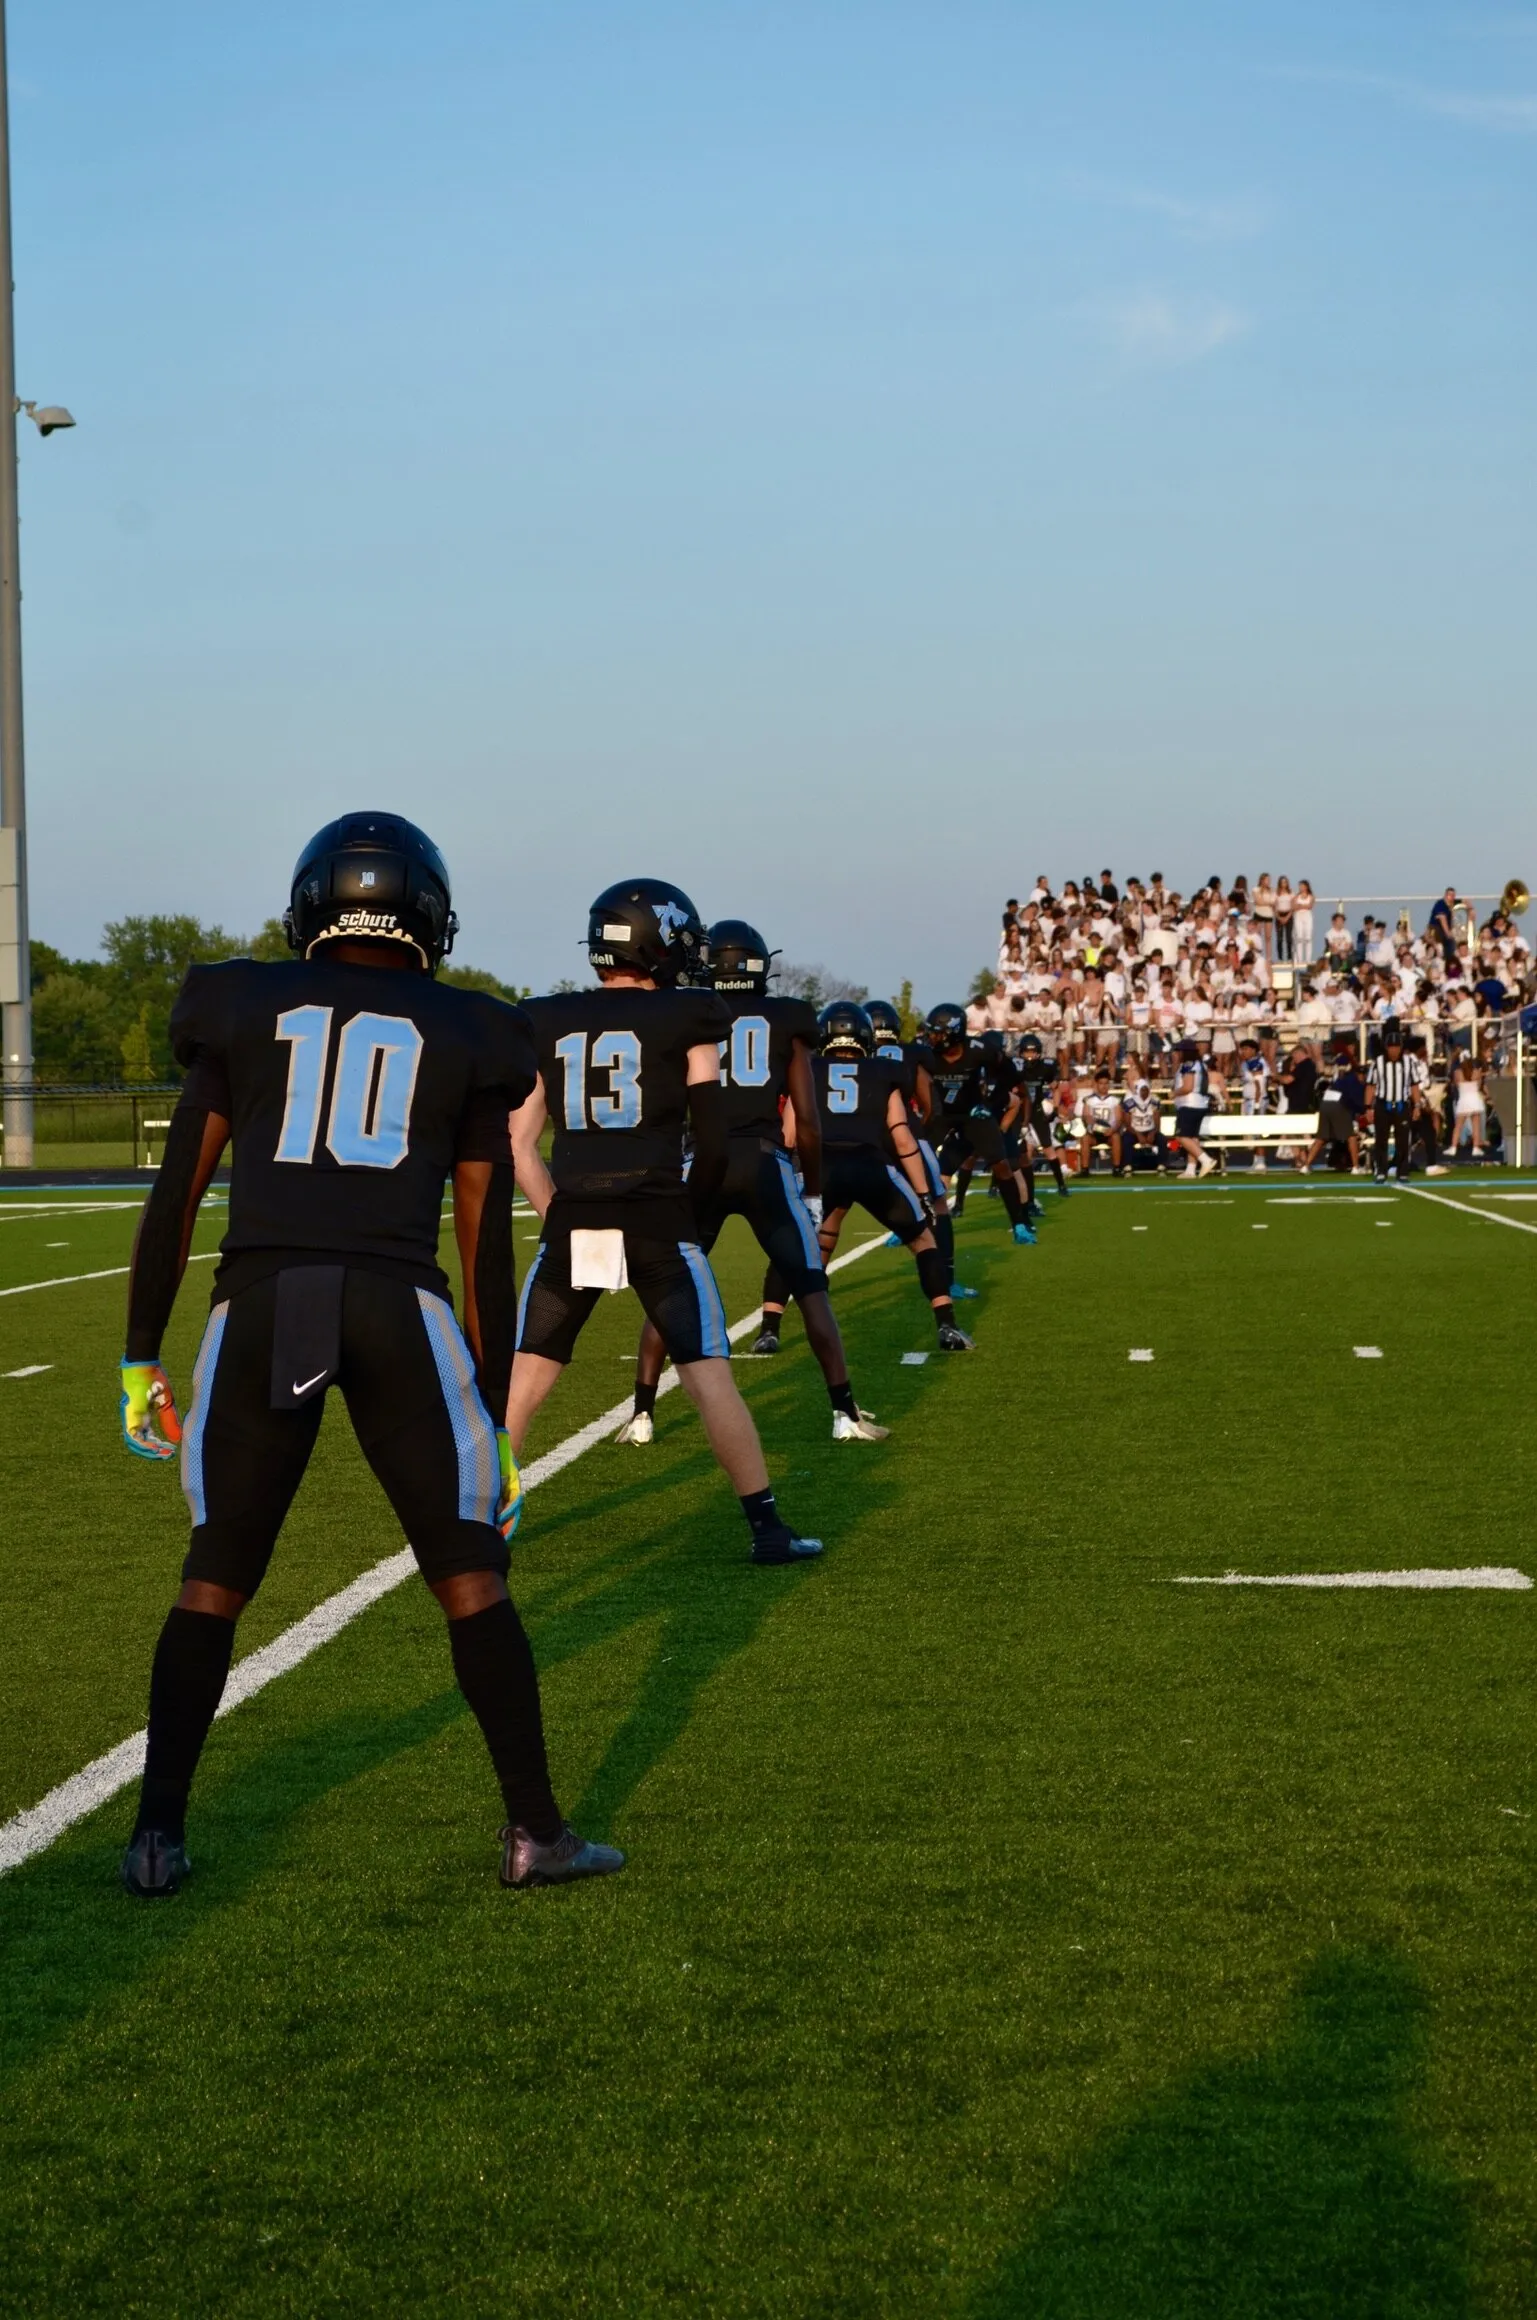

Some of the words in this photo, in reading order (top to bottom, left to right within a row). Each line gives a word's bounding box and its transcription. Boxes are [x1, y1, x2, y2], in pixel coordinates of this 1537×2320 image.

[360, 871, 376, 886] 10
[338, 910, 397, 928] schutt
[714, 980, 754, 990] Riddell
[274, 1004, 424, 1169] 10
[555, 1031, 642, 1129] 13
[827, 1063, 859, 1114] 5
[942, 1081, 963, 1104] 7
